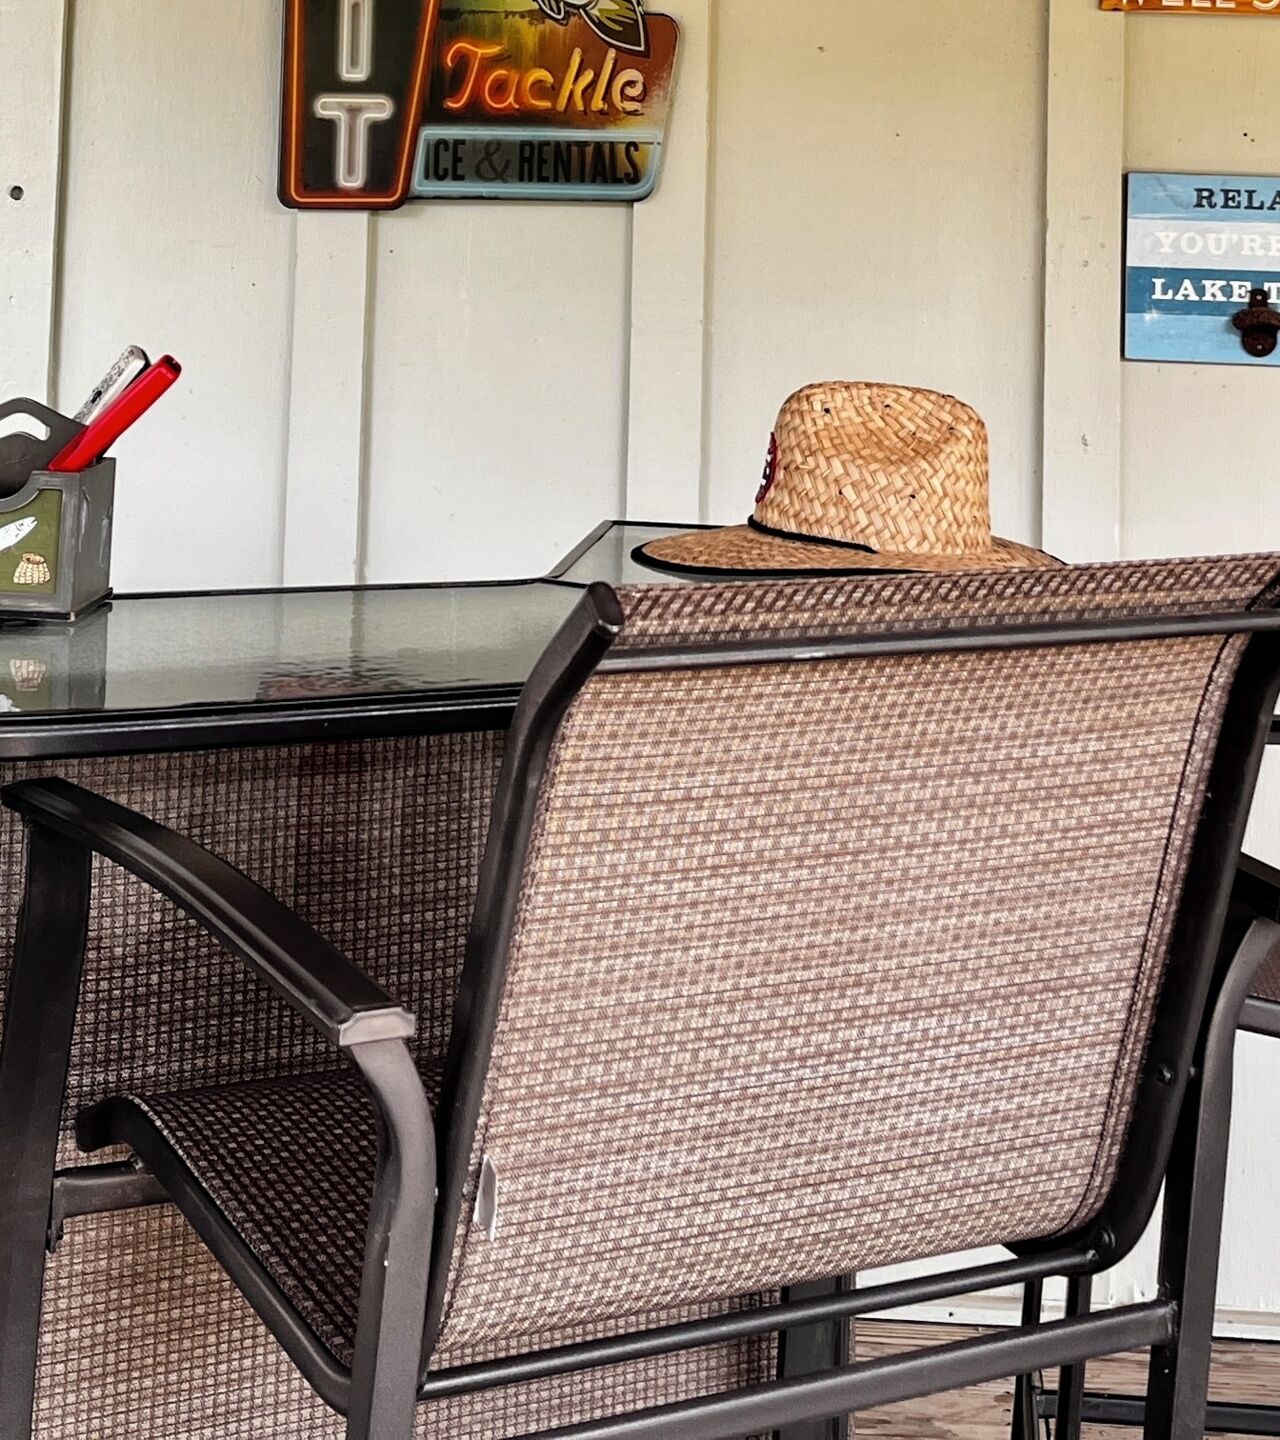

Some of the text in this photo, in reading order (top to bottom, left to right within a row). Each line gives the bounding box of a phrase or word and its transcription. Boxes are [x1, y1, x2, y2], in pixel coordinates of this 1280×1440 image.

[444, 41, 648, 115] Tackle
[423, 138, 641, 185] ICE & RENTALS
[1151, 277, 1252, 303] LAKE
